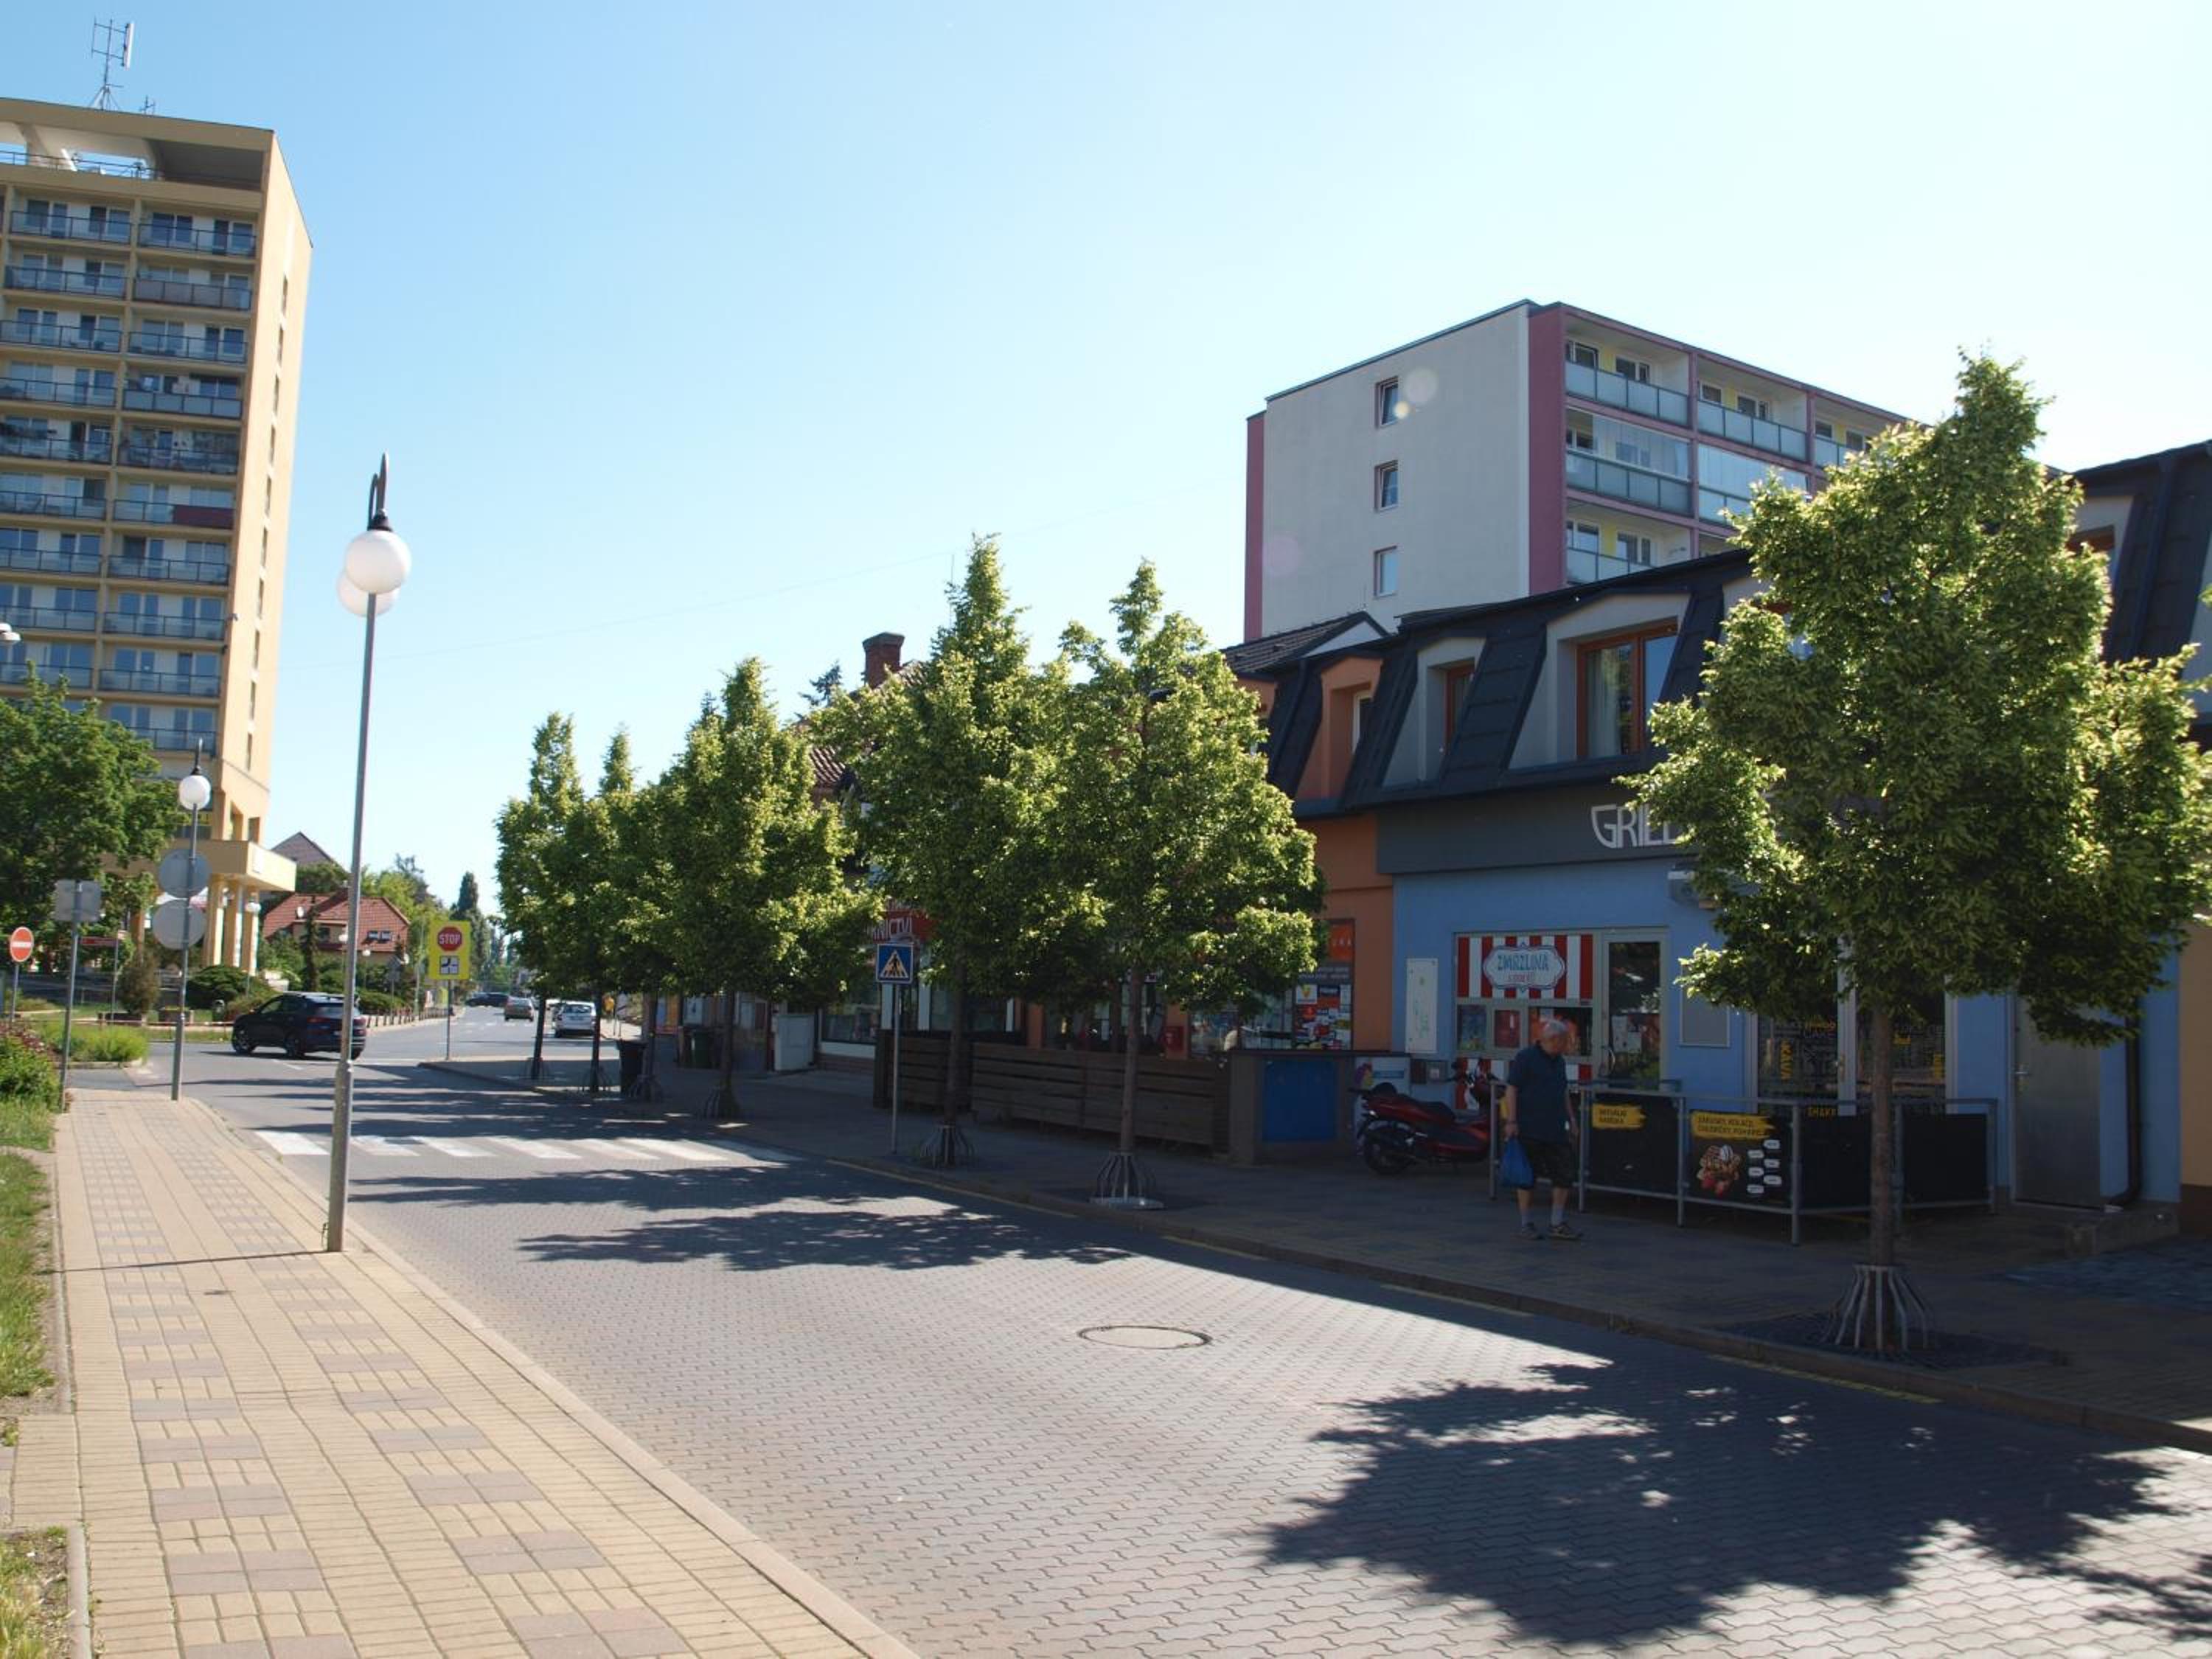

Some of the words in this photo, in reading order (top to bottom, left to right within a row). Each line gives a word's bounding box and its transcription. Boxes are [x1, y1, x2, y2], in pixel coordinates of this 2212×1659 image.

[1590, 804, 1676, 849] GRILL
[439, 933, 461, 945] STOP
[1498, 954, 1549, 971] ZMRZLINA
